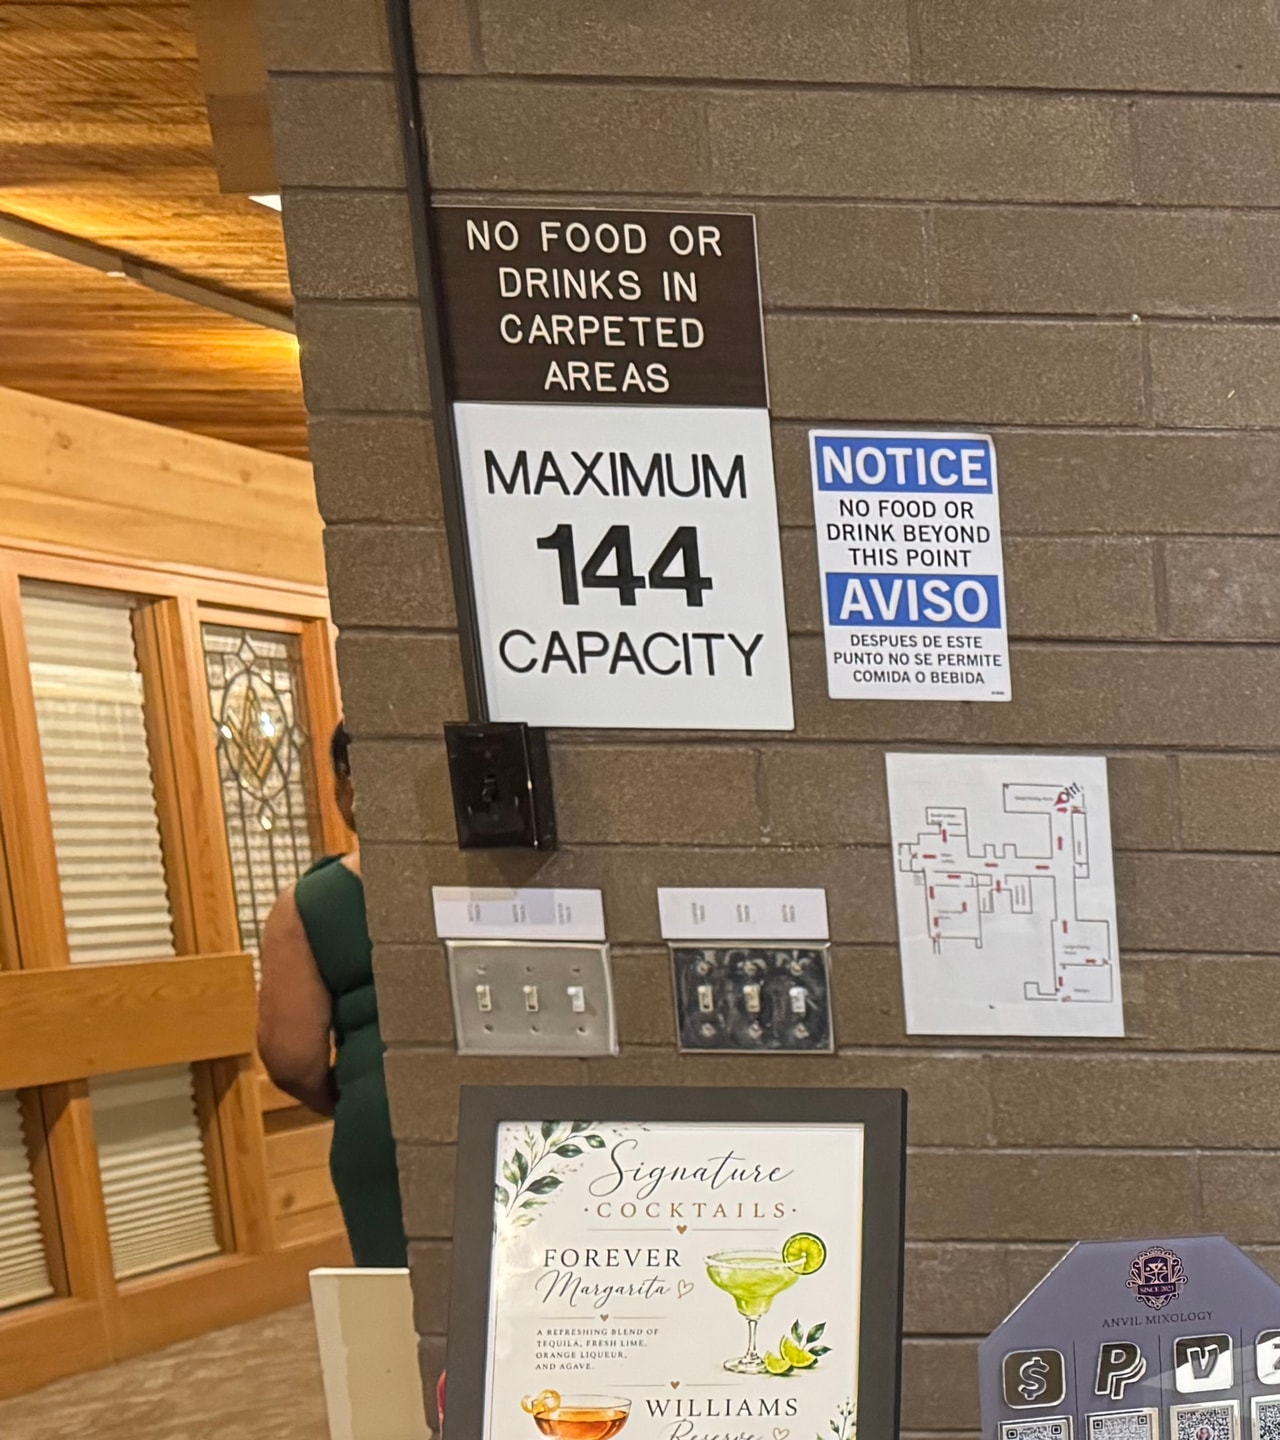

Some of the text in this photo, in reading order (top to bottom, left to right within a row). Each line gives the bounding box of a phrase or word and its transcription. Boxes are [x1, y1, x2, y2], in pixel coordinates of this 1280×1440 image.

[466, 220, 722, 257] NO FOOD OR
[499, 267, 698, 303] DRINKS IN
[500, 314, 705, 348] CARPETED
[544, 362, 669, 393] AREAS
[484, 450, 747, 499] MAXIMUM
[822, 446, 988, 487] NOTICE
[839, 499, 975, 520] NO FOOD OR
[827, 523, 991, 545] DRINK BEYOND
[536, 523, 713, 608] 144
[848, 547, 972, 569] THIS POINT
[839, 579, 989, 623] AVISO
[850, 634, 983, 649] DESPUES DE ESTE
[498, 629, 764, 677] CAPACITY
[833, 652, 1002, 668] PUNTO NO SE PERMITE
[852, 669, 985, 685] COMIDA O BEBIDA
[588, 1139, 795, 1200] Signature
[596, 1202, 786, 1219] COCKTAILS
[543, 1248, 682, 1268] FOREVER
[535, 1269, 671, 1310] Margarita
[1102, 1311, 1214, 1328] ANVIL MIXOLOGY
[546, 1328, 608, 1336] REFRESHING
[611, 1328, 643, 1336] BLEND
[646, 1328, 659, 1336] OF
[536, 1351, 576, 1359] ORANGE
[645, 1397, 799, 1418] WILLIAMS
